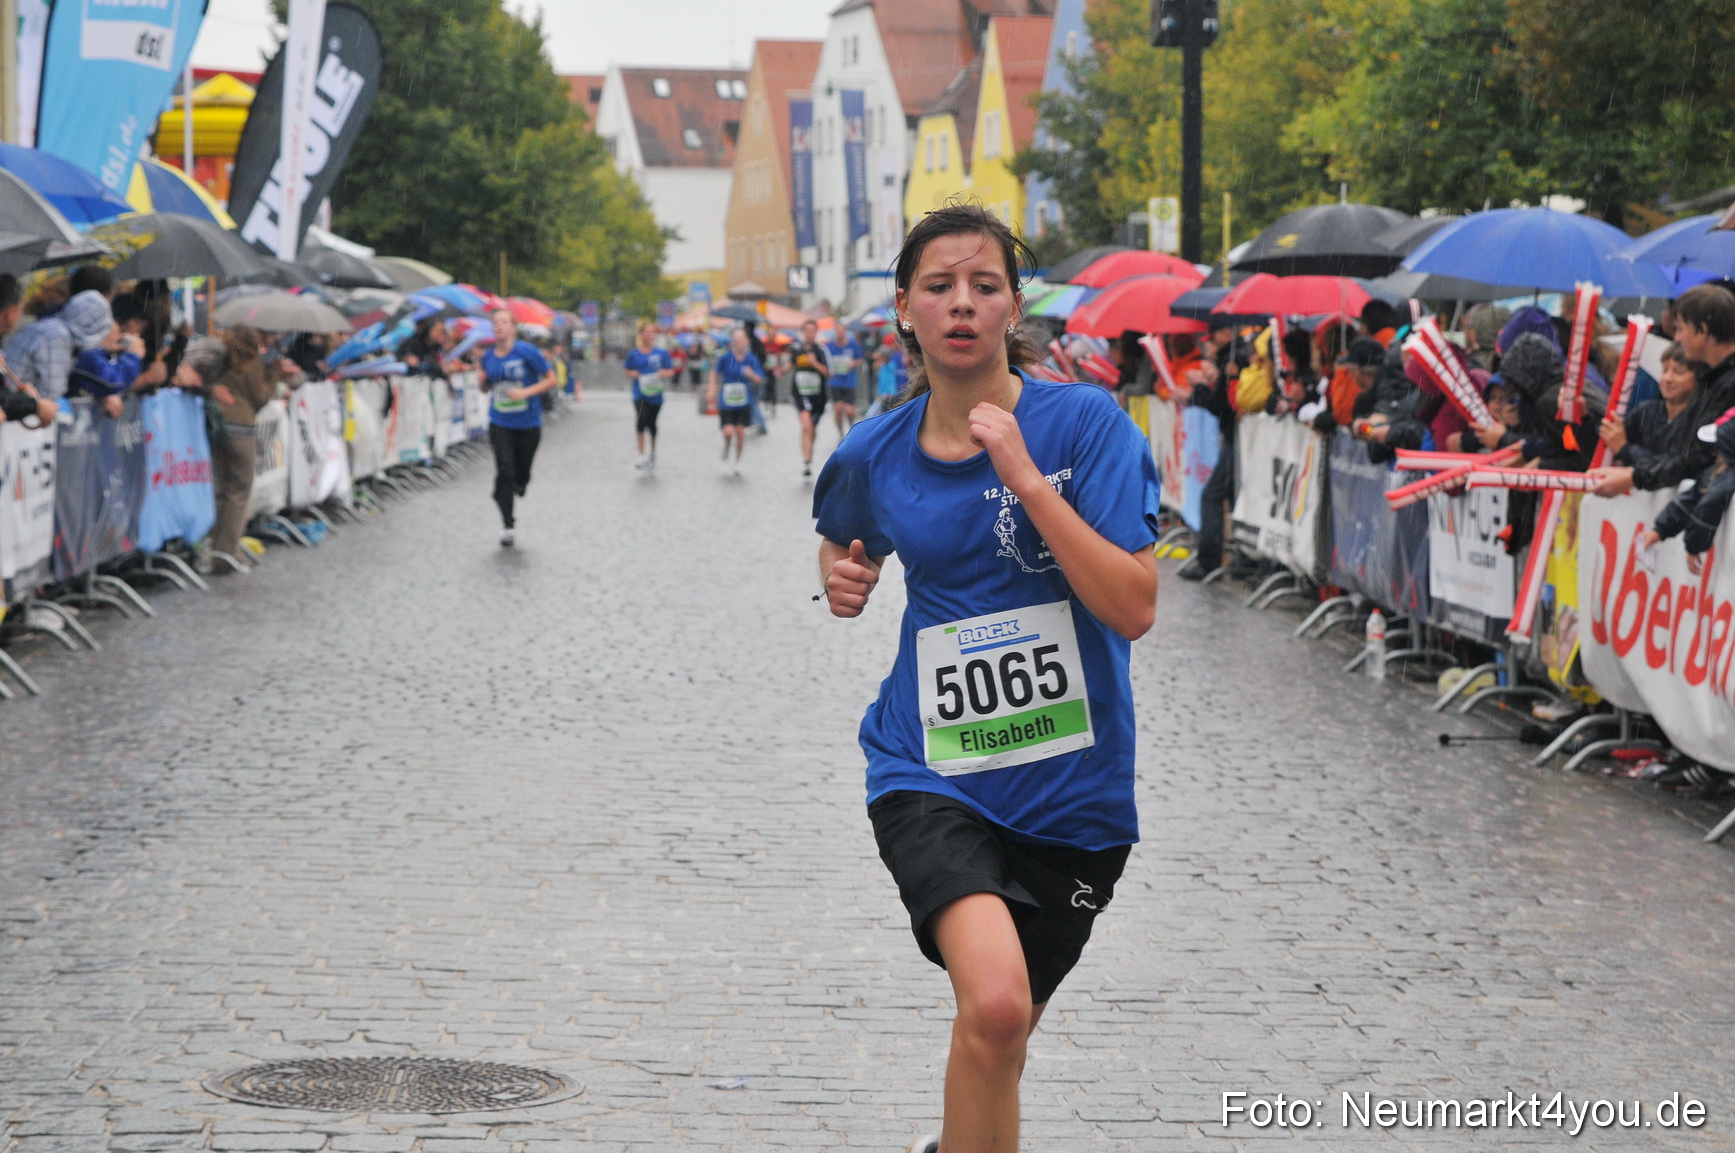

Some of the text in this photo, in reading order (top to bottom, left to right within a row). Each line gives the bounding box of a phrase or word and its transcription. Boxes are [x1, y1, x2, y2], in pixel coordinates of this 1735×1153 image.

[983, 488, 1001, 500] 12.
[958, 619, 1020, 645] BOCK
[936, 644, 1068, 720] 5065
[960, 714, 1056, 752] Elisabeth
